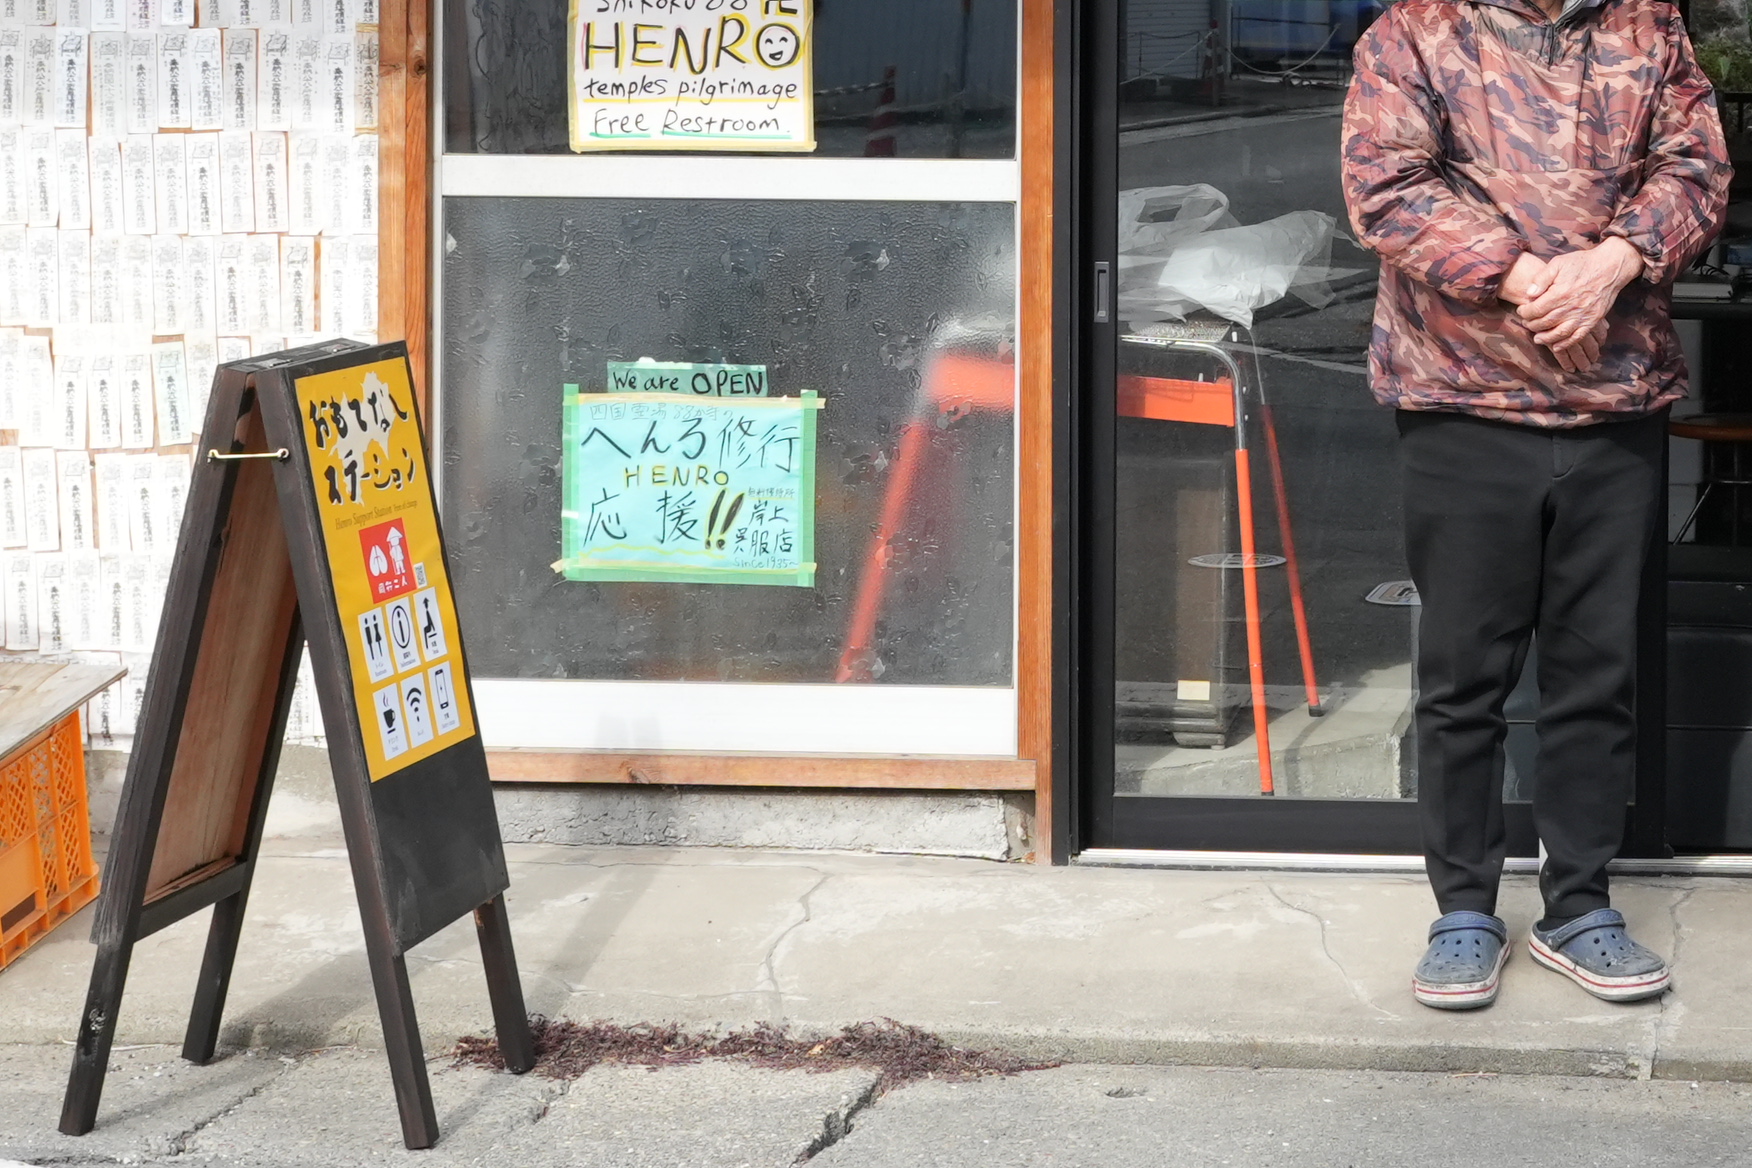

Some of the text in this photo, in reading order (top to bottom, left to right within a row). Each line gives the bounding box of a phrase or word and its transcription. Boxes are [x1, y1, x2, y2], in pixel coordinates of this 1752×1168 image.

[584, 75, 798, 110] temples pilgrimage
[594, 108, 650, 134] Free
[612, 370, 763, 396] We are OPEN
[581, 415, 801, 473] へんろ修行
[324, 447, 416, 506] ステーション
[623, 464, 729, 487] HENRO
[748, 498, 789, 527] 岸上
[733, 527, 793, 558] 呉服店
